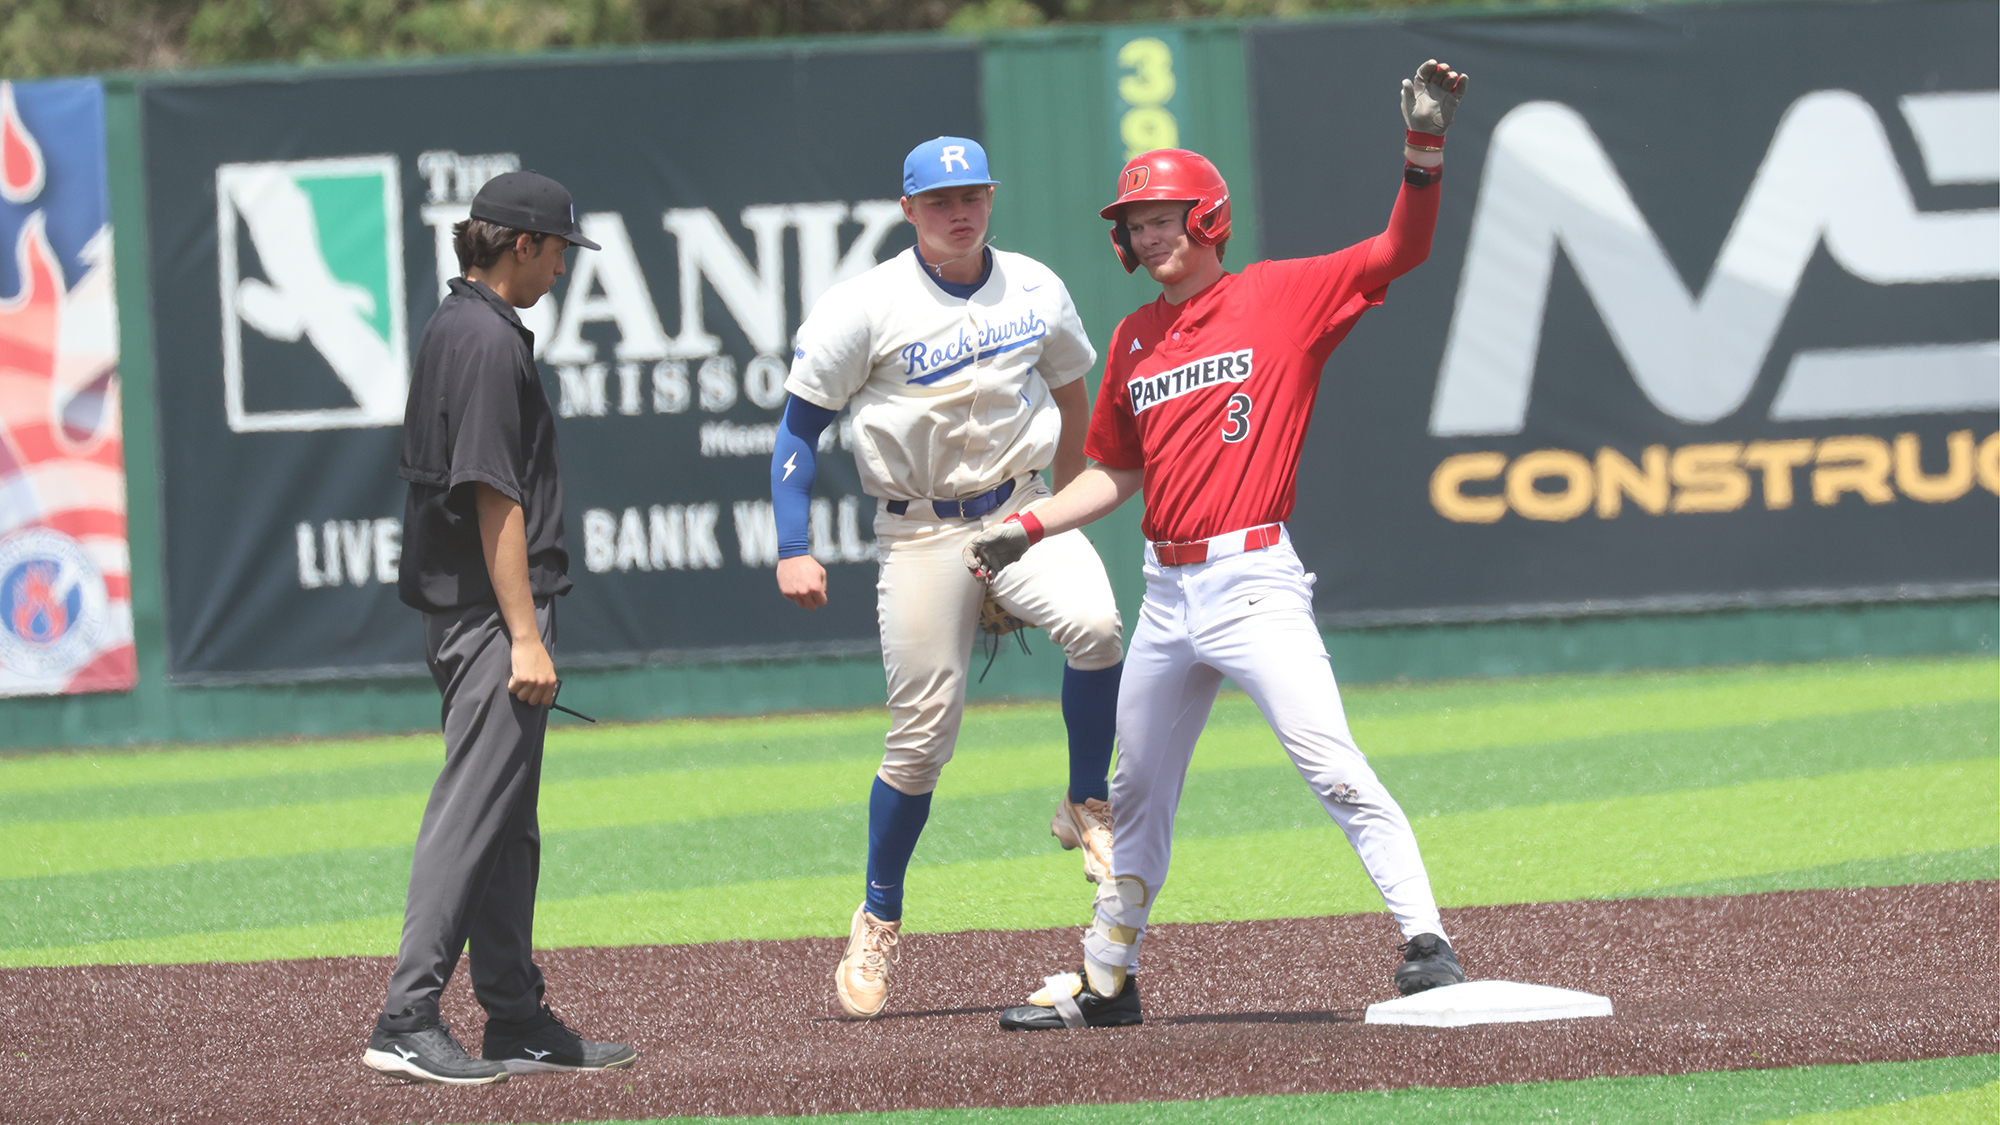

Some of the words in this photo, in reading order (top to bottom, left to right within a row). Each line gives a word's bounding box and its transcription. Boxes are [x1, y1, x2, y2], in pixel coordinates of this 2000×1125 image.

[940, 145, 970, 173] R
[1122, 165, 1150, 198] D
[902, 308, 1047, 378] Rockhurst
[556, 351, 790, 418] MISSO
[1127, 348, 1254, 417] PANTHERS
[1221, 392, 1253, 444] 3
[296, 517, 402, 589] LIVE
[583, 501, 723, 574] BANK
[732, 494, 880, 569] WLL.
